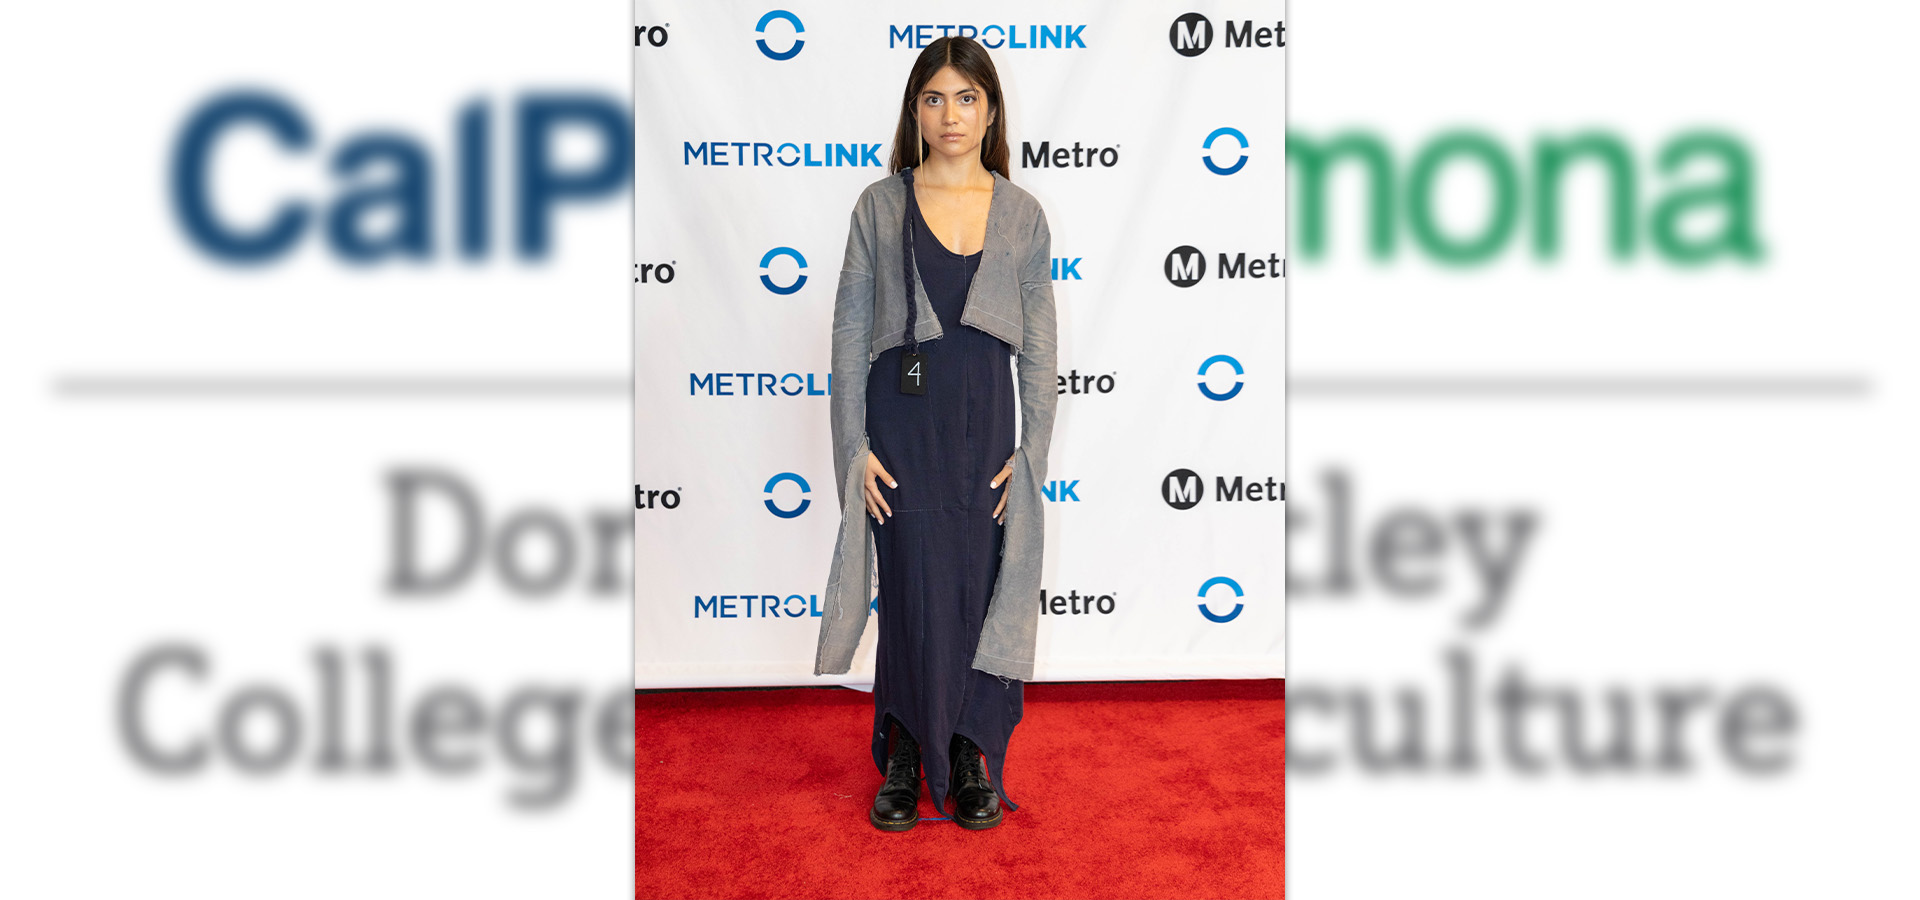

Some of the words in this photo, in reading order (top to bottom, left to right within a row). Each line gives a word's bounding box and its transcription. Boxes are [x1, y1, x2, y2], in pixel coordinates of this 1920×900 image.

[889, 24, 1087, 49] METROLINK
[1178, 21, 1205, 49] M
[684, 141, 882, 168] METROLINK
[635, 261, 676, 284] ro
[1172, 252, 1200, 280] M
[1218, 253, 1285, 280] Met
[907, 361, 922, 387] 4
[1169, 476, 1197, 503] M
